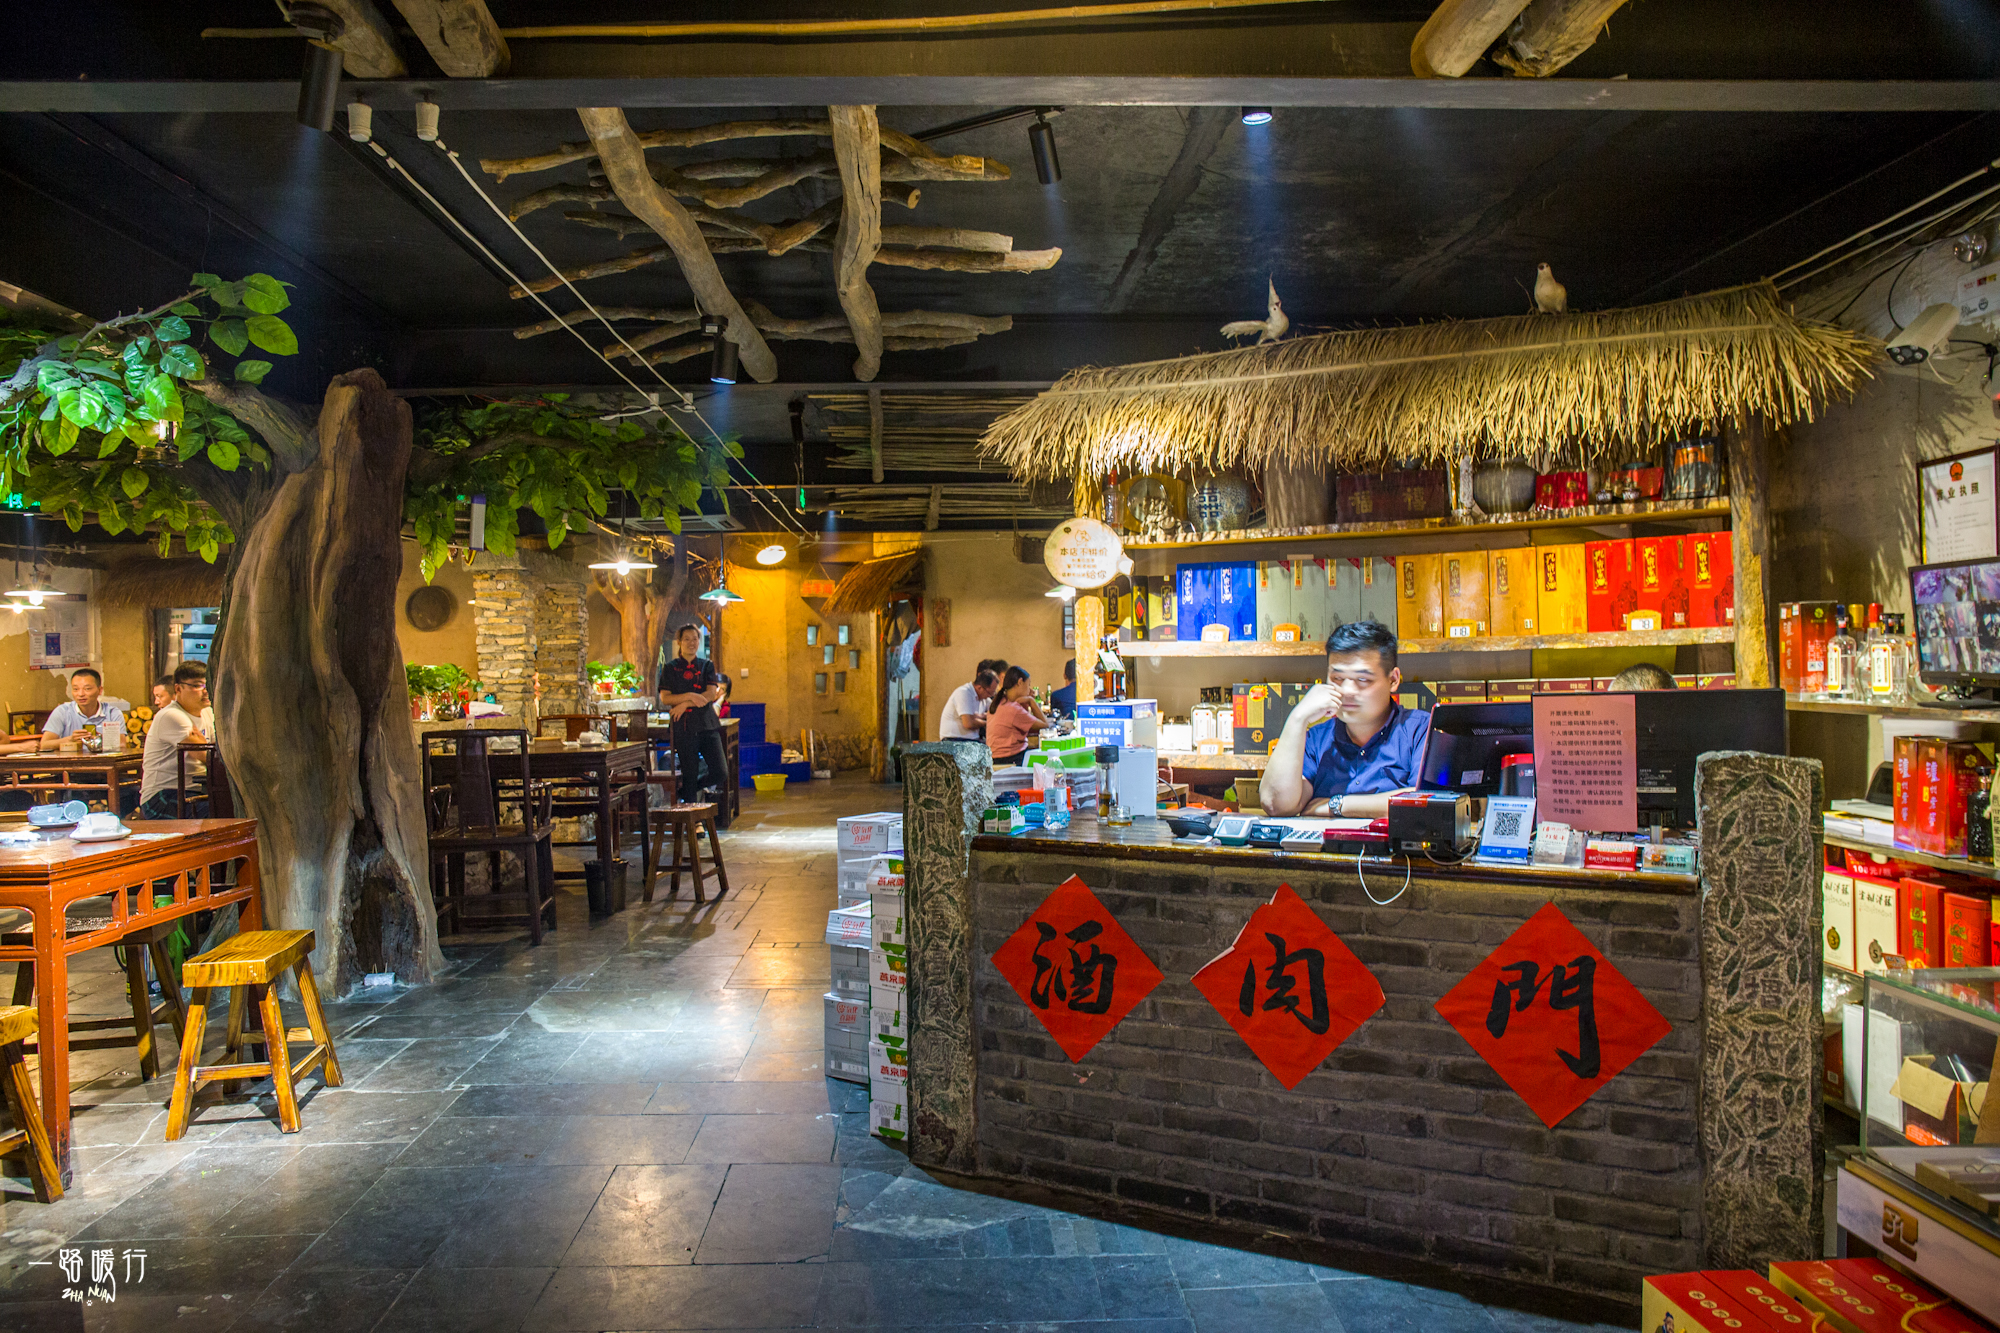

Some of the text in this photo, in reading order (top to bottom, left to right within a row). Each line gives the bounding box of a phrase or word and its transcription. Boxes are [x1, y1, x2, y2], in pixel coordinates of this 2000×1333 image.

[1348, 490, 1373, 515] 福
[1936, 481, 1979, 501] 营业执照
[1031, 920, 1118, 1015] 酒
[1486, 954, 1597, 1079] 門
